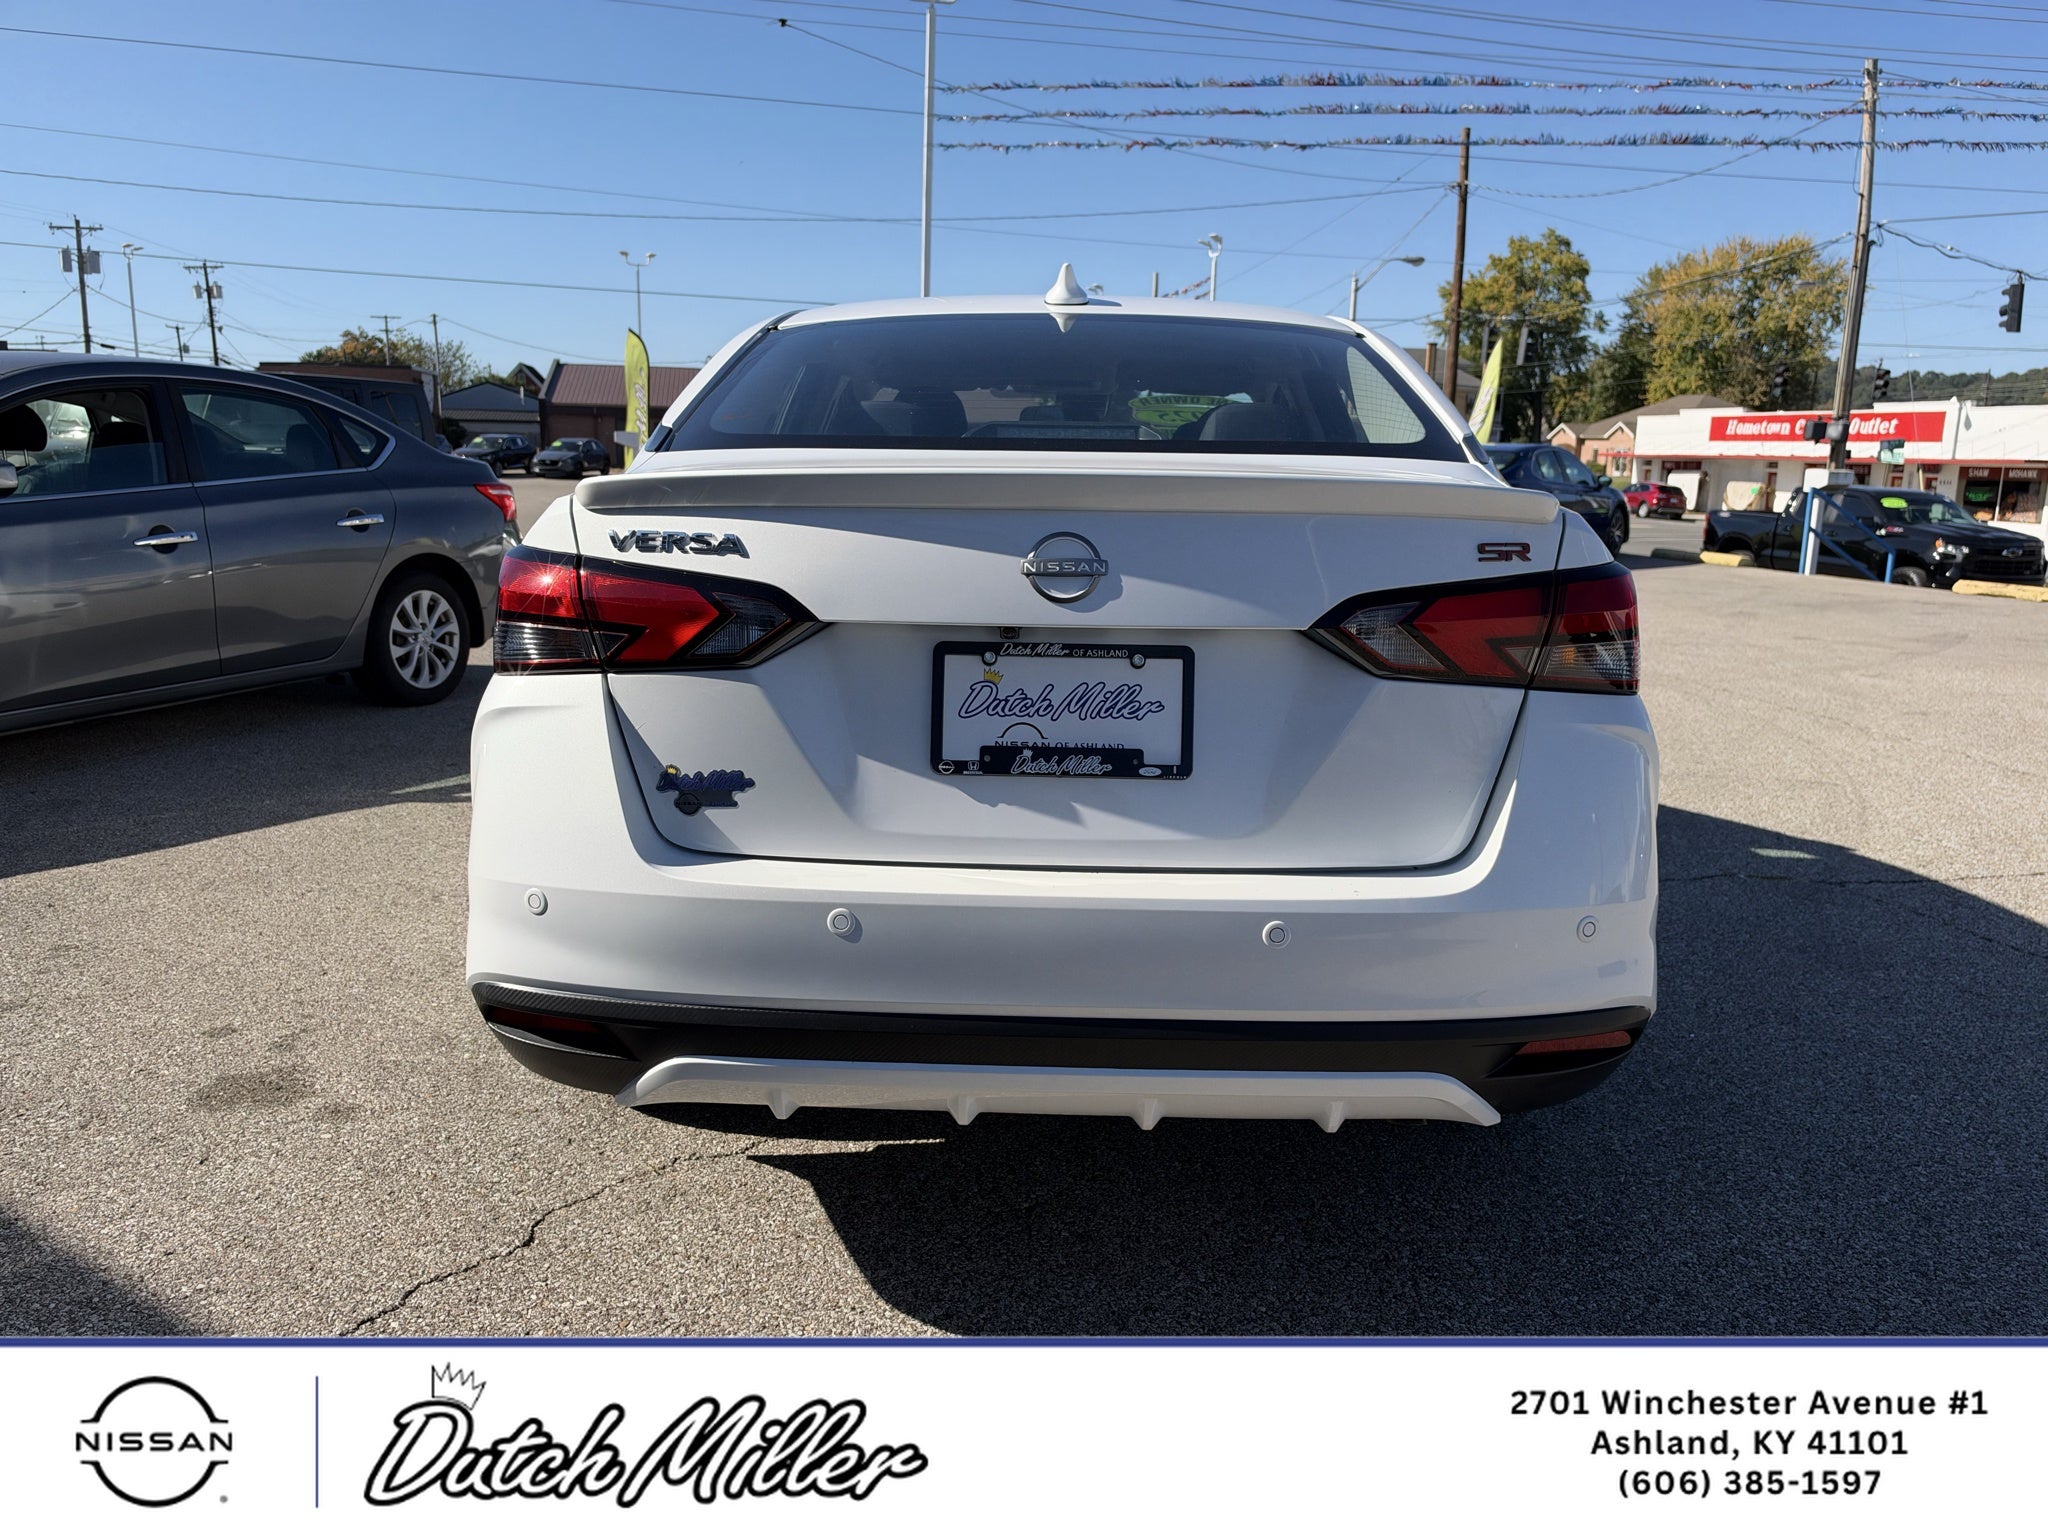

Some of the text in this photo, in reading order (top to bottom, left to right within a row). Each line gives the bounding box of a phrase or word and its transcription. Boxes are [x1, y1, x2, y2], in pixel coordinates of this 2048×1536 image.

[1725, 419, 1790, 435] Hometown
[1849, 417, 1900, 435] Outlet
[1968, 468, 1989, 477] SHAW
[2008, 470, 2038, 479] MOHAWK
[608, 529, 750, 559] VERSA
[1477, 543, 1532, 563] SR
[1023, 561, 1106, 573] NISSAN
[1000, 642, 1129, 658] Dutch Miller OF ASHLAND
[958, 680, 1165, 721] Dutch Miller
[1010, 755, 1112, 775] Dutch Miller
